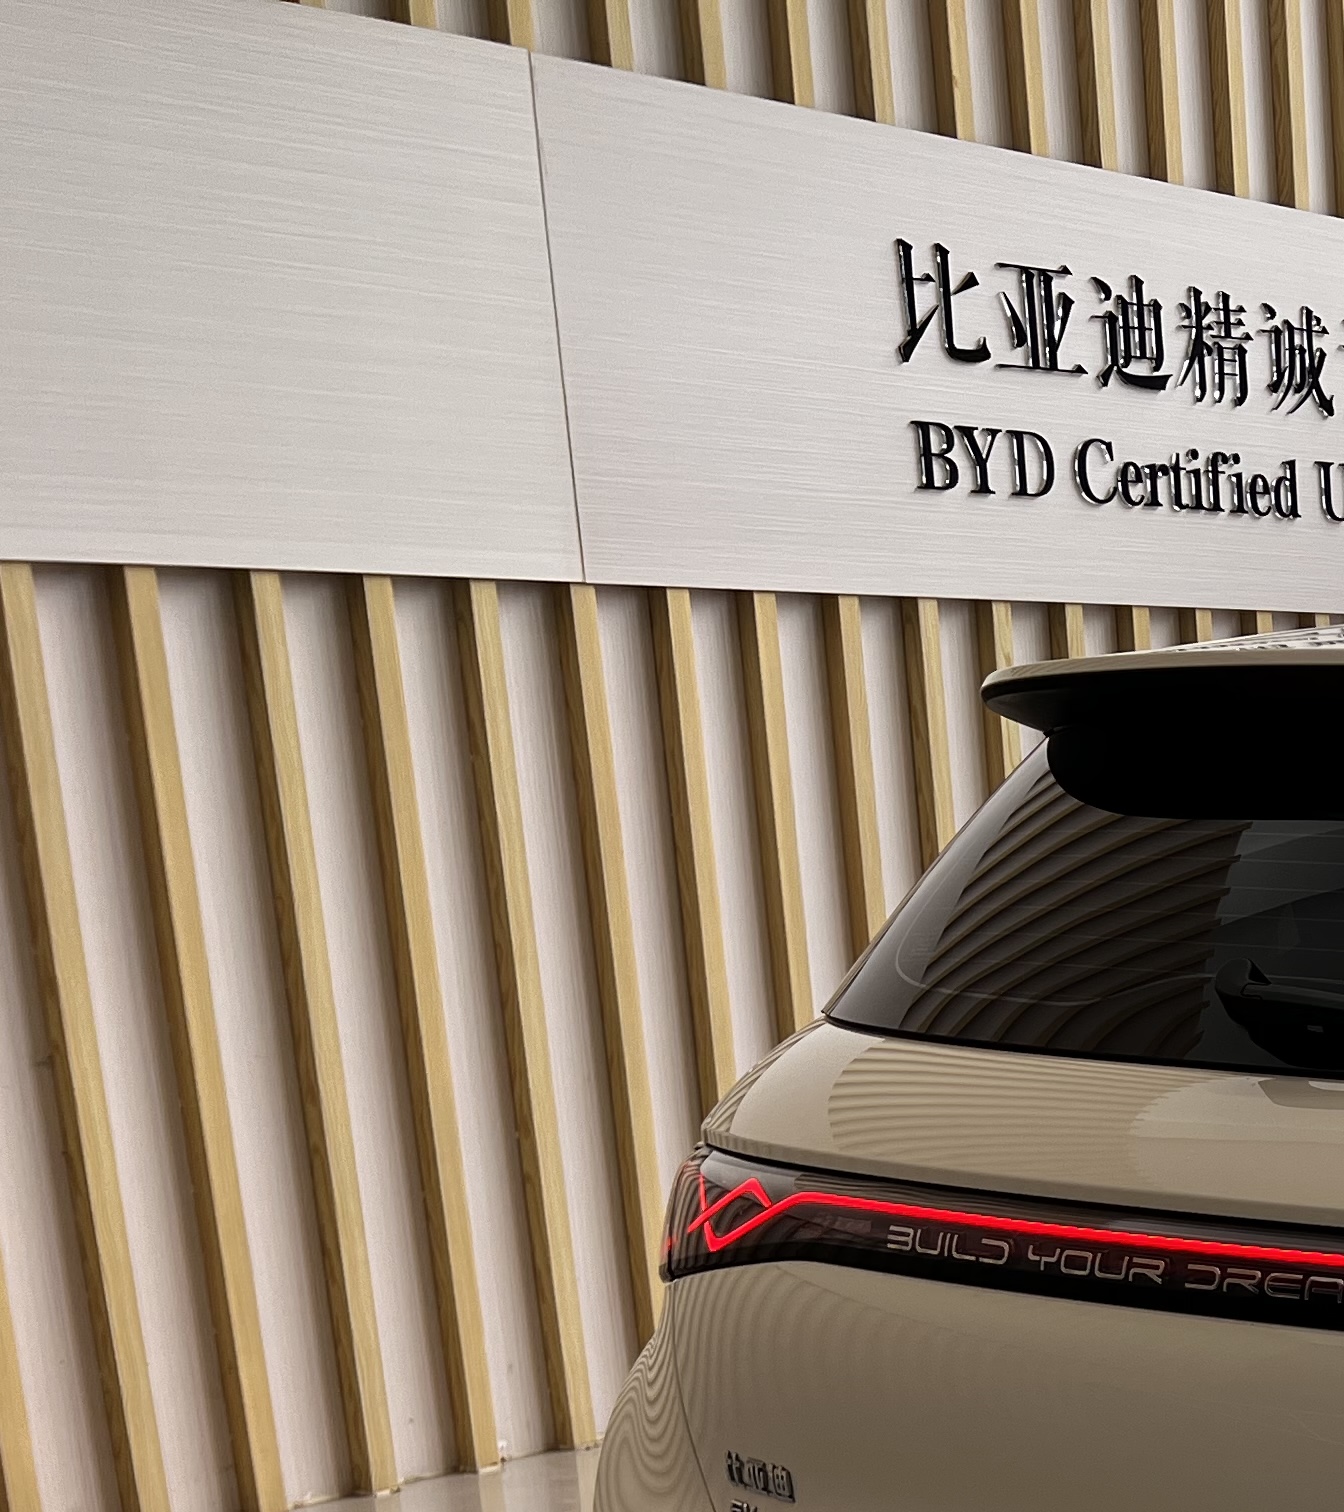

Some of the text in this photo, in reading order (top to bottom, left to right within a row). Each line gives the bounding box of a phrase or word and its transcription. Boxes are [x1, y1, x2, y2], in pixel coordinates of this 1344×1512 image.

[910, 420, 1056, 498] BYD
[1073, 438, 1302, 520] Certified
[886, 1224, 1009, 1265] BUILD
[1028, 1245, 1166, 1286] YOUR
